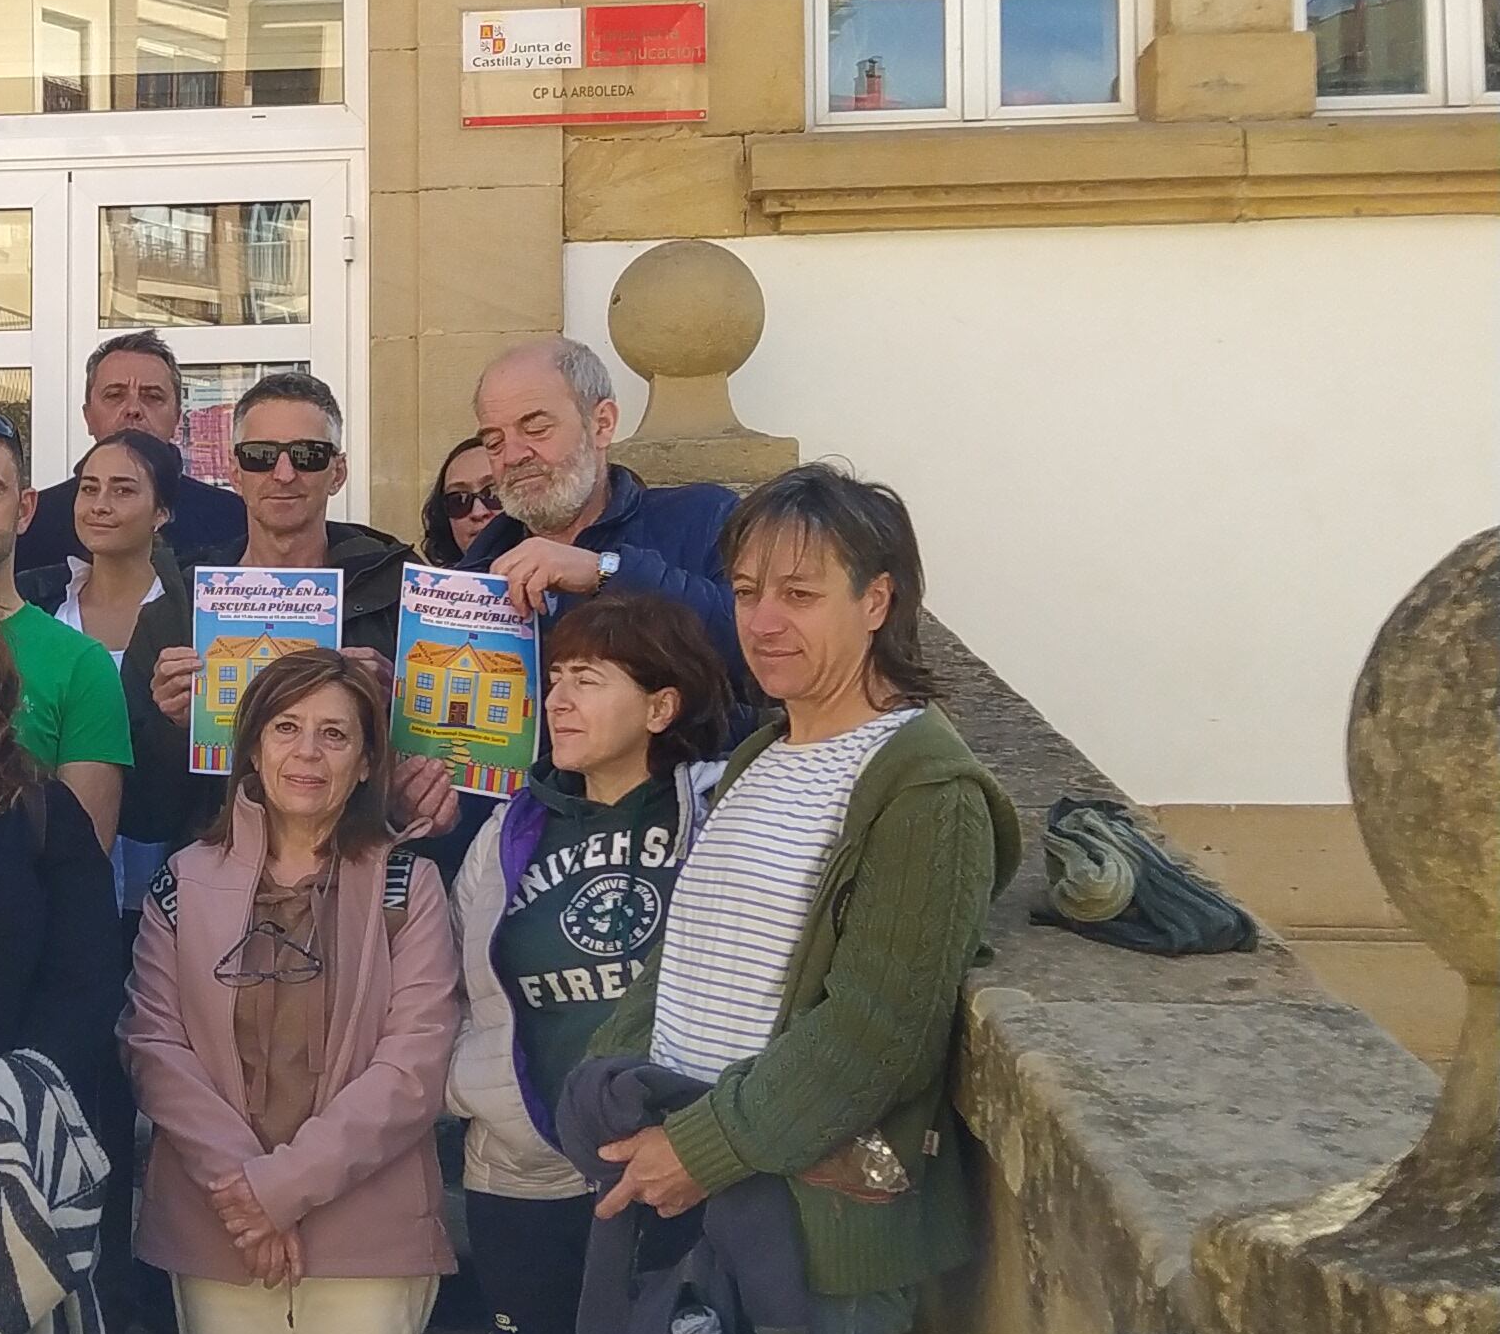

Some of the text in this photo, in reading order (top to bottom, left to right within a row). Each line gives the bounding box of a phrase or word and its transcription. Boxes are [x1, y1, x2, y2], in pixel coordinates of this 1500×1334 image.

[511, 41, 572, 54] Junta de
[472, 54, 572, 68] Castilla y León
[532, 85, 635, 99] CP LA ARBOLEDA
[203, 584, 330, 597] MATRICÚLATE EN LA
[409, 585, 501, 606] MATRICÚLATE
[210, 600, 322, 613] ESCUELA PÚBLICA
[414, 603, 471, 620] ESCUELA
